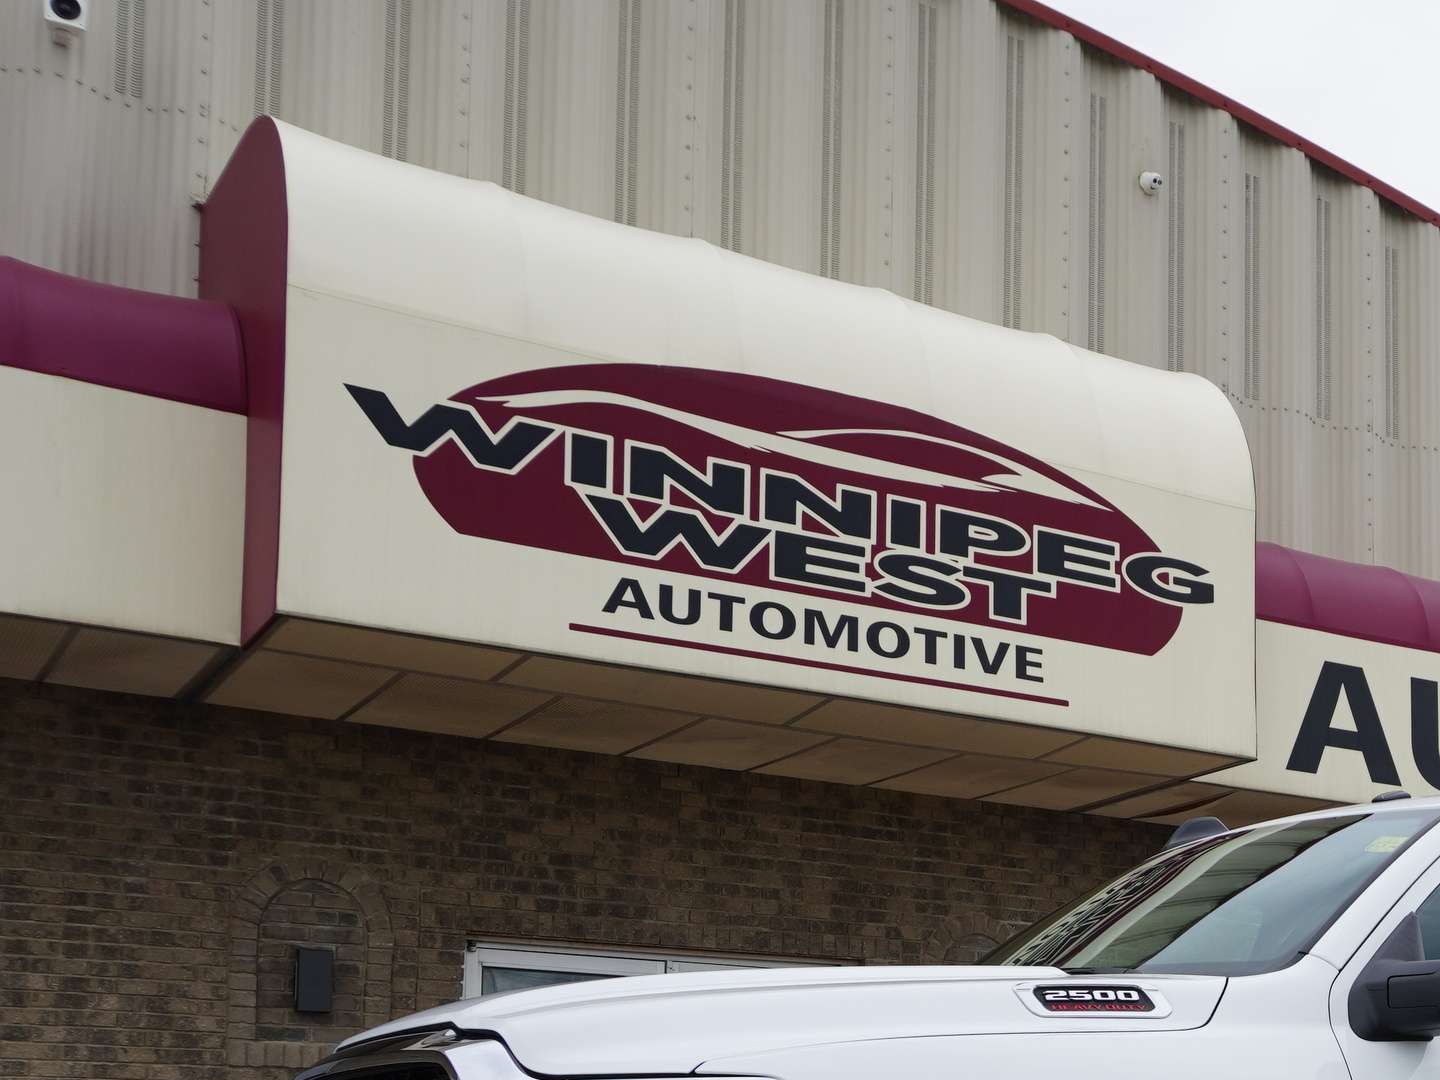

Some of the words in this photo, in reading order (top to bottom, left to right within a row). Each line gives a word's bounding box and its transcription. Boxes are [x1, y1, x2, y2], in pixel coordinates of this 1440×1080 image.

[344, 383, 1215, 605] WINNIPEG
[585, 495, 1053, 625] WEST
[601, 577, 1045, 683] AUTOMOTIVE
[1043, 989, 1140, 1001] 2500
